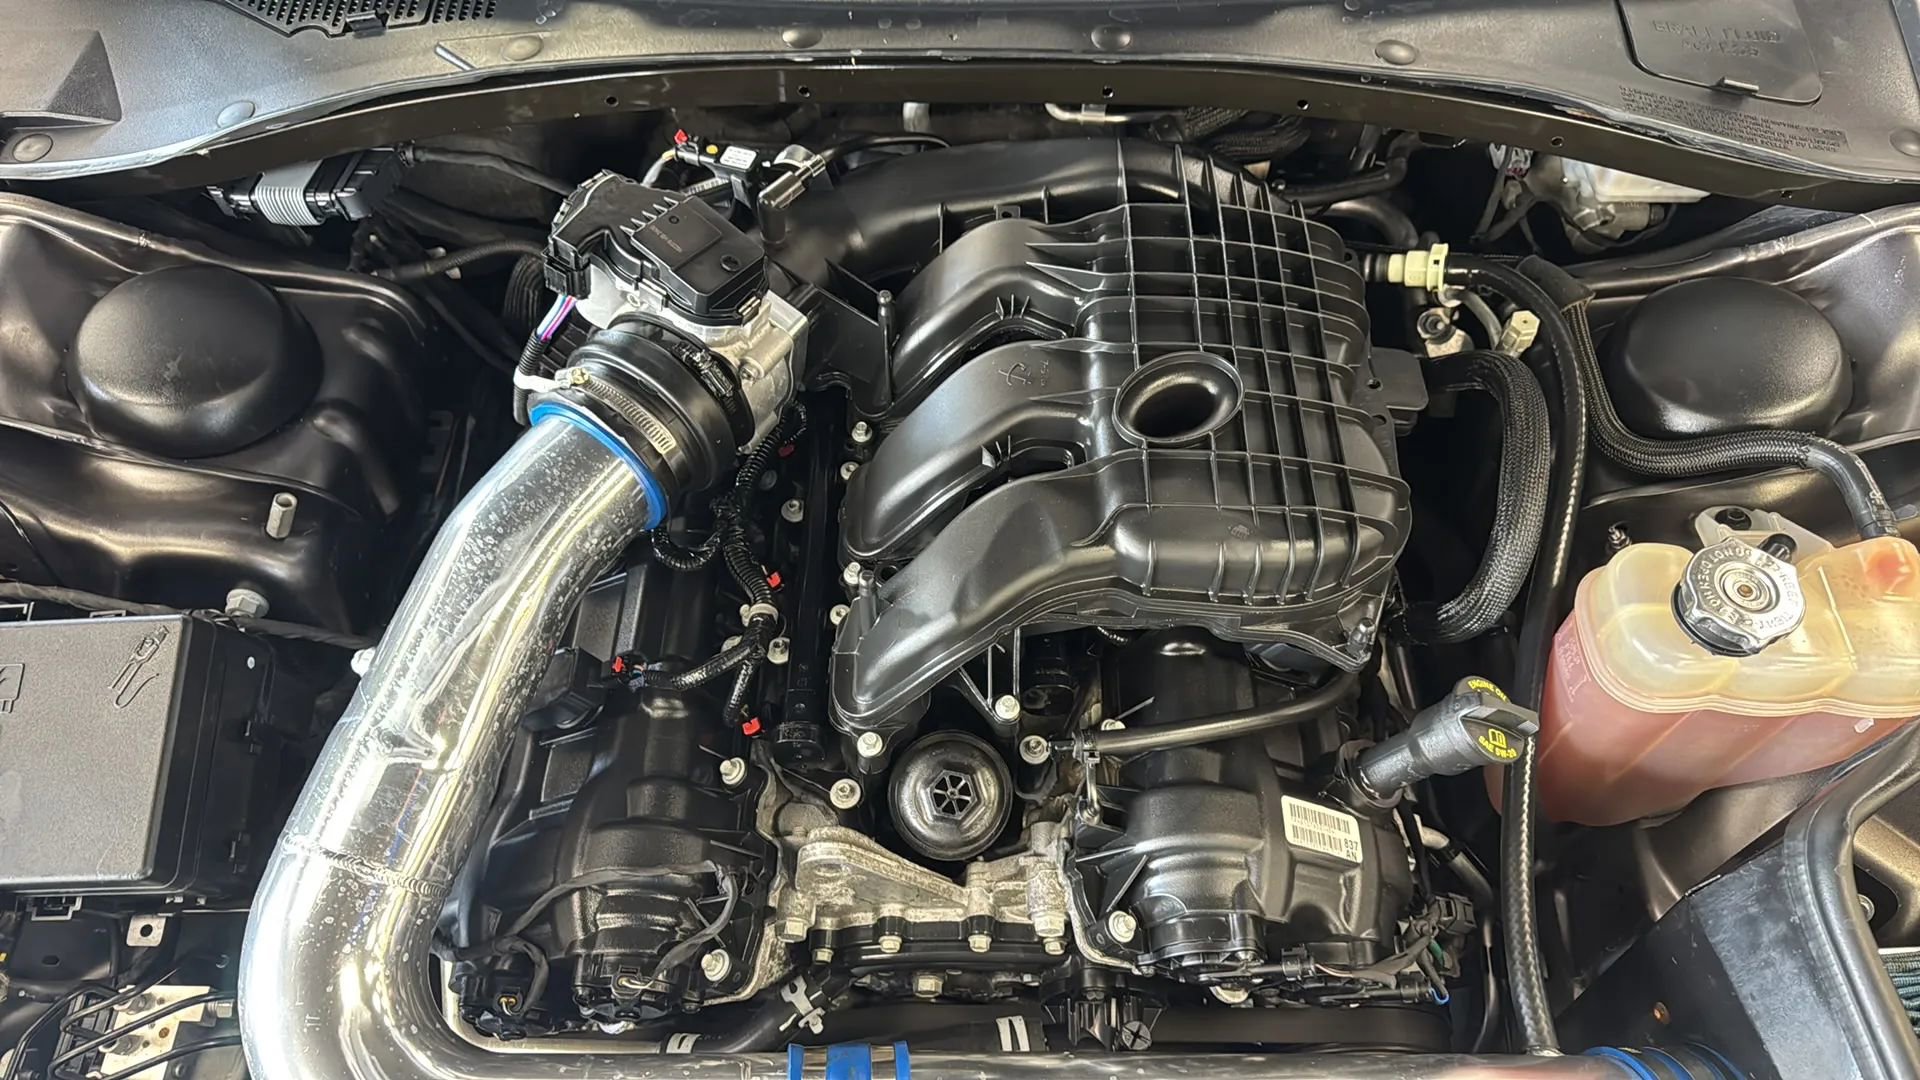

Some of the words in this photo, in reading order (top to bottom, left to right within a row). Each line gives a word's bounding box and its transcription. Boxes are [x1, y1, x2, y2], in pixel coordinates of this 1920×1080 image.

[1710, 547, 1734, 563] NOT
[1697, 560, 1713, 589] OPEN
[1467, 679, 1495, 692] ENGINE
[1494, 688, 1507, 702] OIL
[1478, 735, 1495, 753] SAE
[1343, 838, 1359, 851] 837
[1346, 850, 1358, 862] AN
